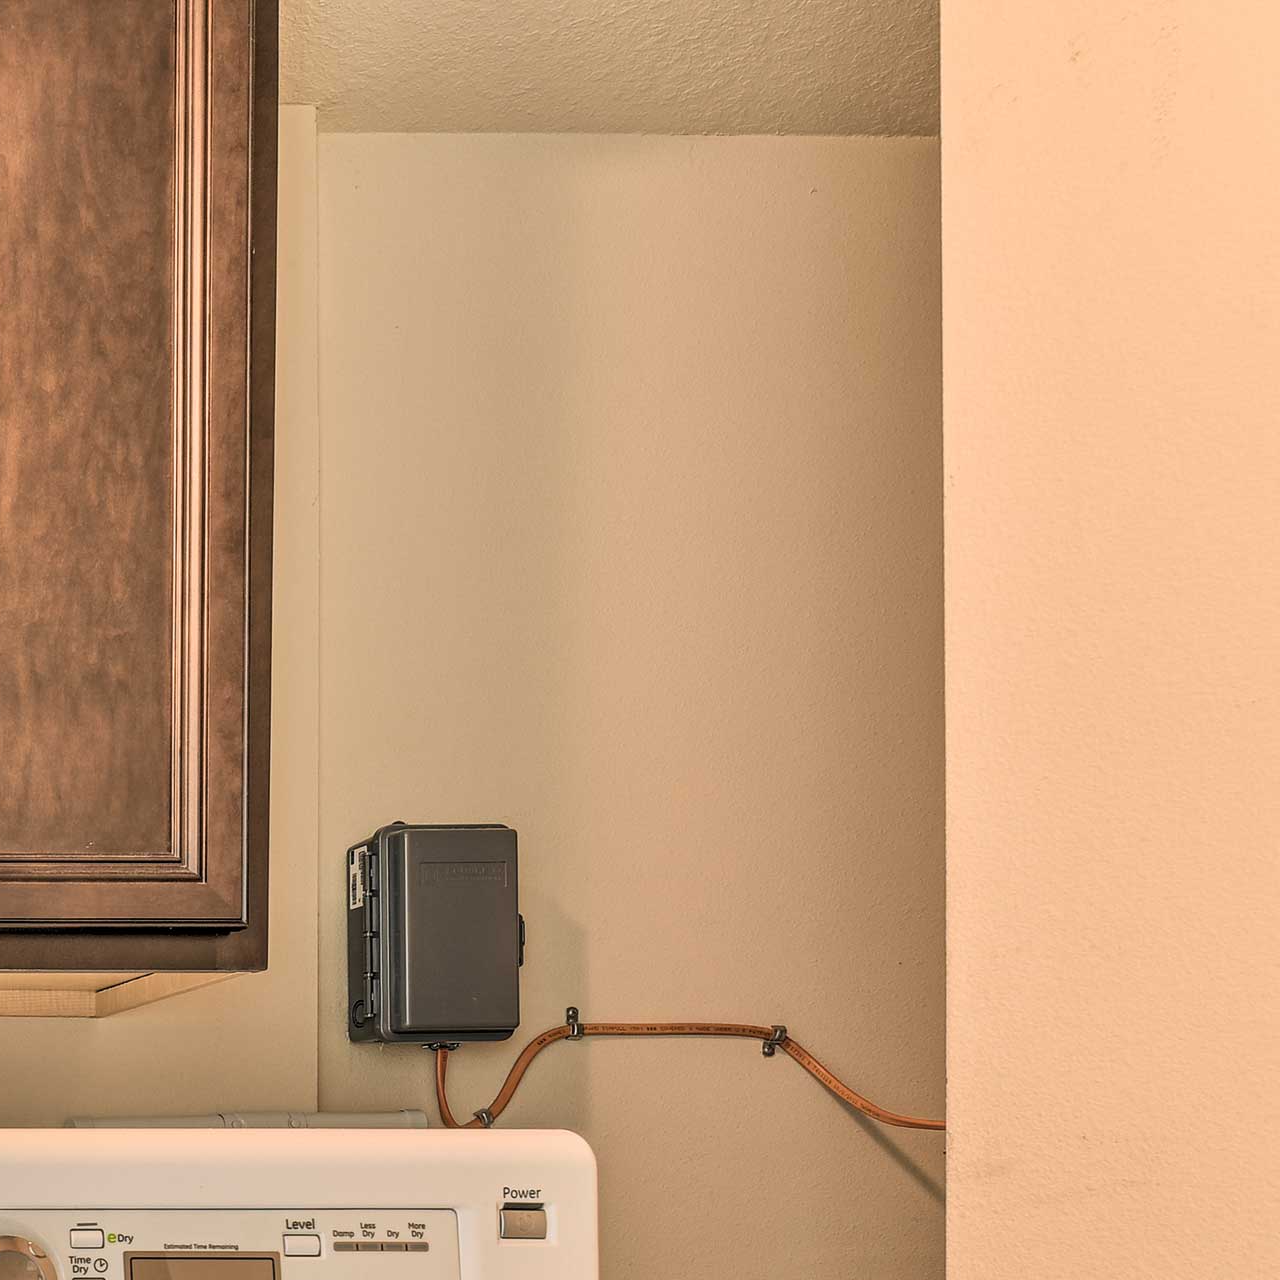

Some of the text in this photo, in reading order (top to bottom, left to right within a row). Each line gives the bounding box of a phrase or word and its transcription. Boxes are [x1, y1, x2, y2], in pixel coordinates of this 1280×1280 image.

[503, 1187, 542, 1199] Power
[285, 1219, 315, 1230] Level
[360, 1222, 376, 1230] Less
[408, 1222, 426, 1230] More
[332, 1230, 355, 1238] Damp
[362, 1230, 375, 1239] Dry
[387, 1230, 400, 1239] Dry
[411, 1230, 424, 1239] Dry
[208, 1243, 239, 1251] Remaining
[69, 1256, 91, 1264] Time
[72, 1264, 89, 1275] Dry
